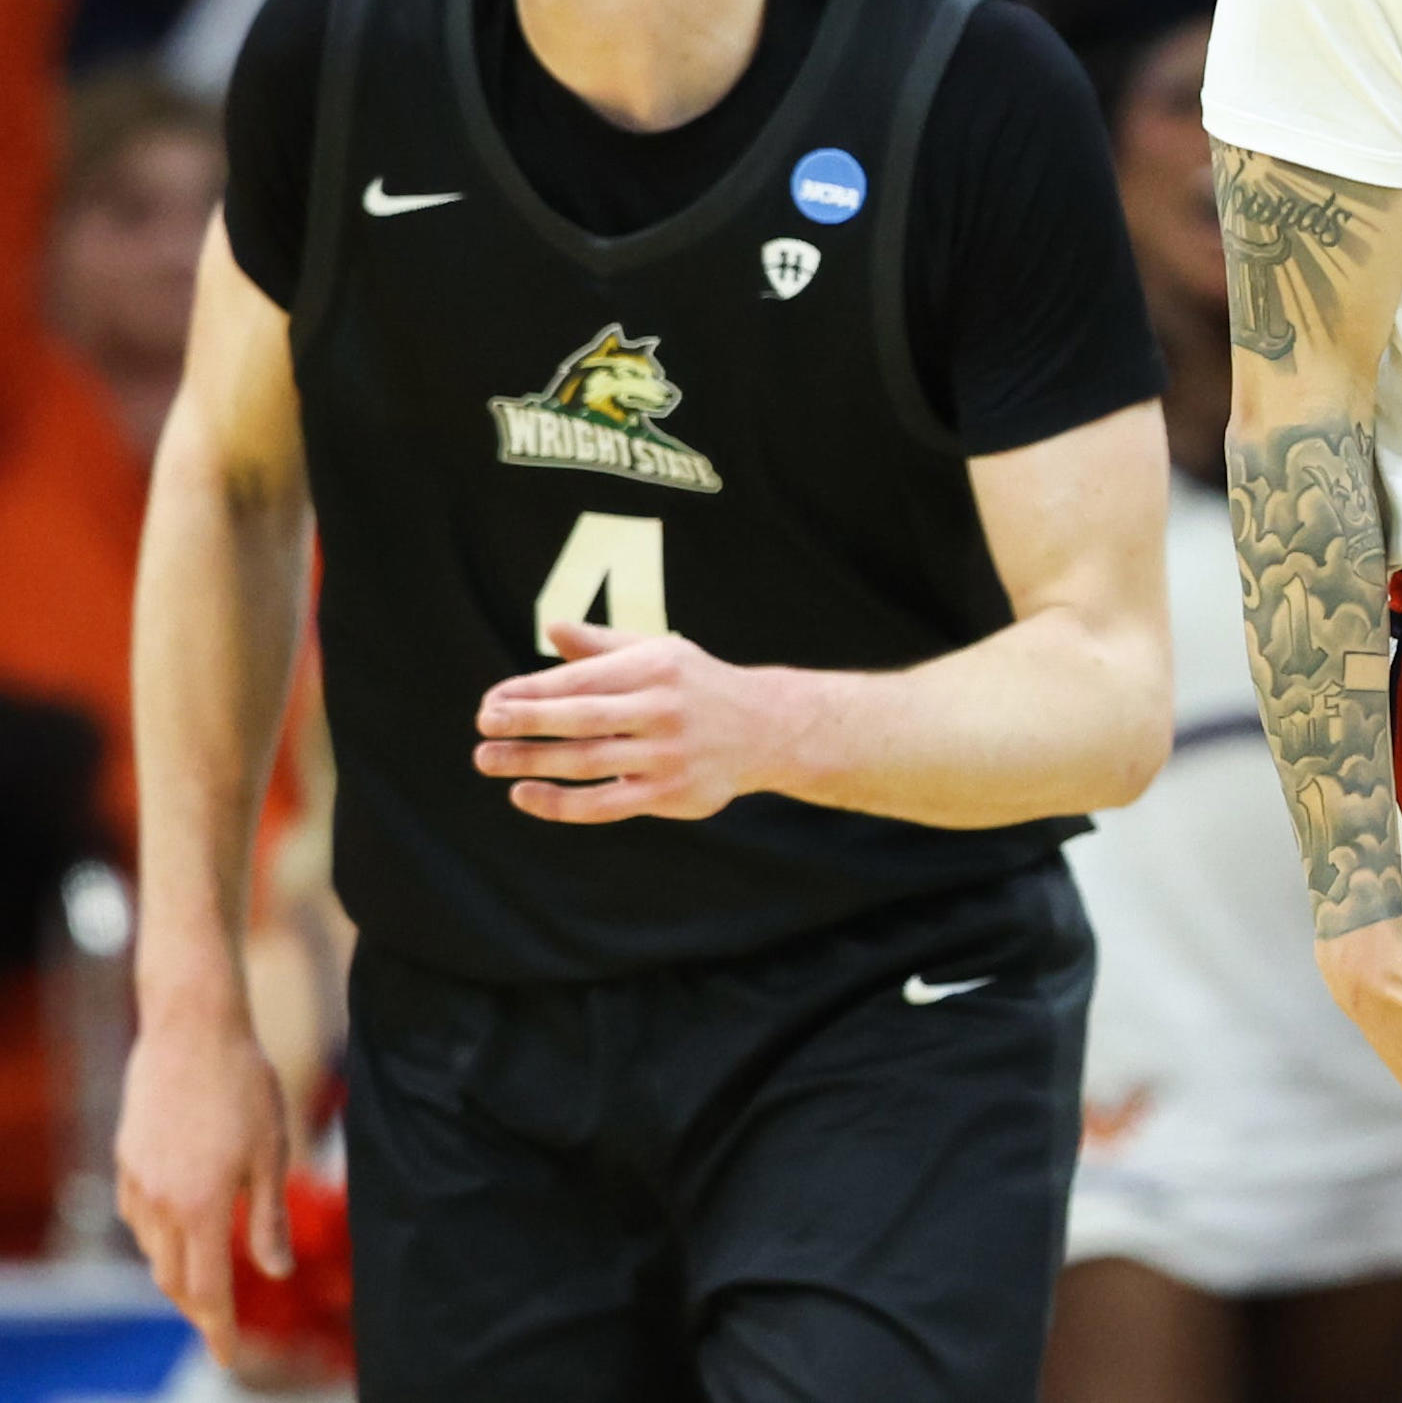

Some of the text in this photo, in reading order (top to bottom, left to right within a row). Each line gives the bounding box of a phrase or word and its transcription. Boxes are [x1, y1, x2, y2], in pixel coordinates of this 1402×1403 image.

[506, 407, 722, 491] WRIGHT STATE
[535, 512, 670, 657] 4
